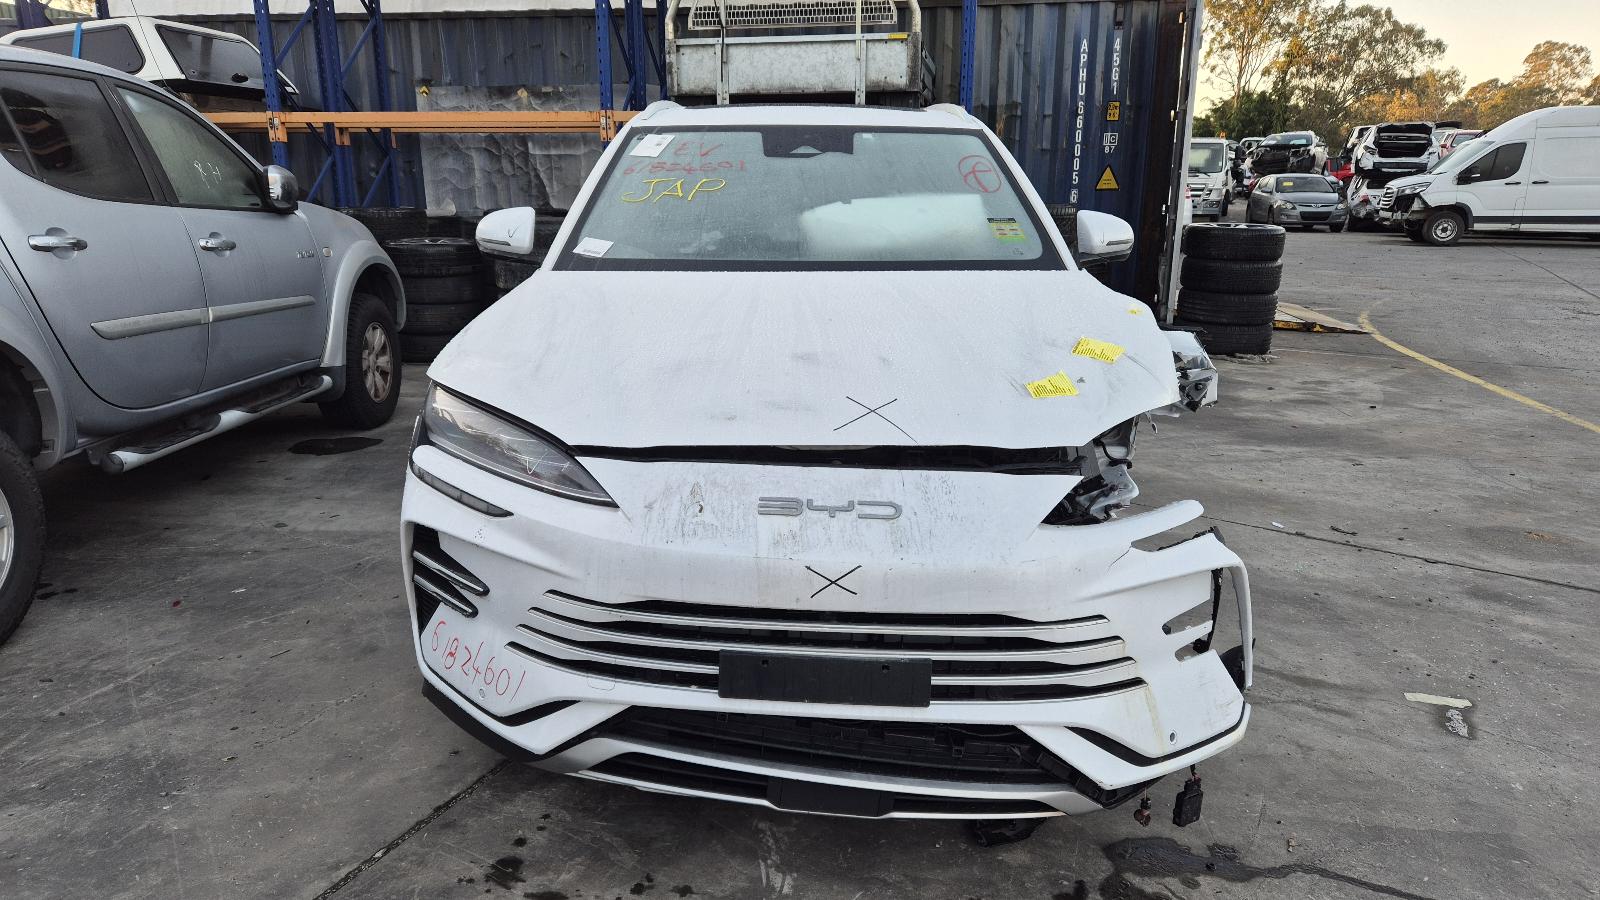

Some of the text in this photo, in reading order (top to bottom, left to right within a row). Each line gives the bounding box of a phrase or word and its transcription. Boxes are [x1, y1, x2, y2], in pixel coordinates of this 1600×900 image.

[1079, 39, 1088, 95] APHU
[1112, 38, 1120, 94] 45G1
[1073, 102, 1084, 184] 660005
[621, 178, 726, 203] JAP
[758, 497, 903, 520] BYD
[431, 620, 527, 703] 61824601
